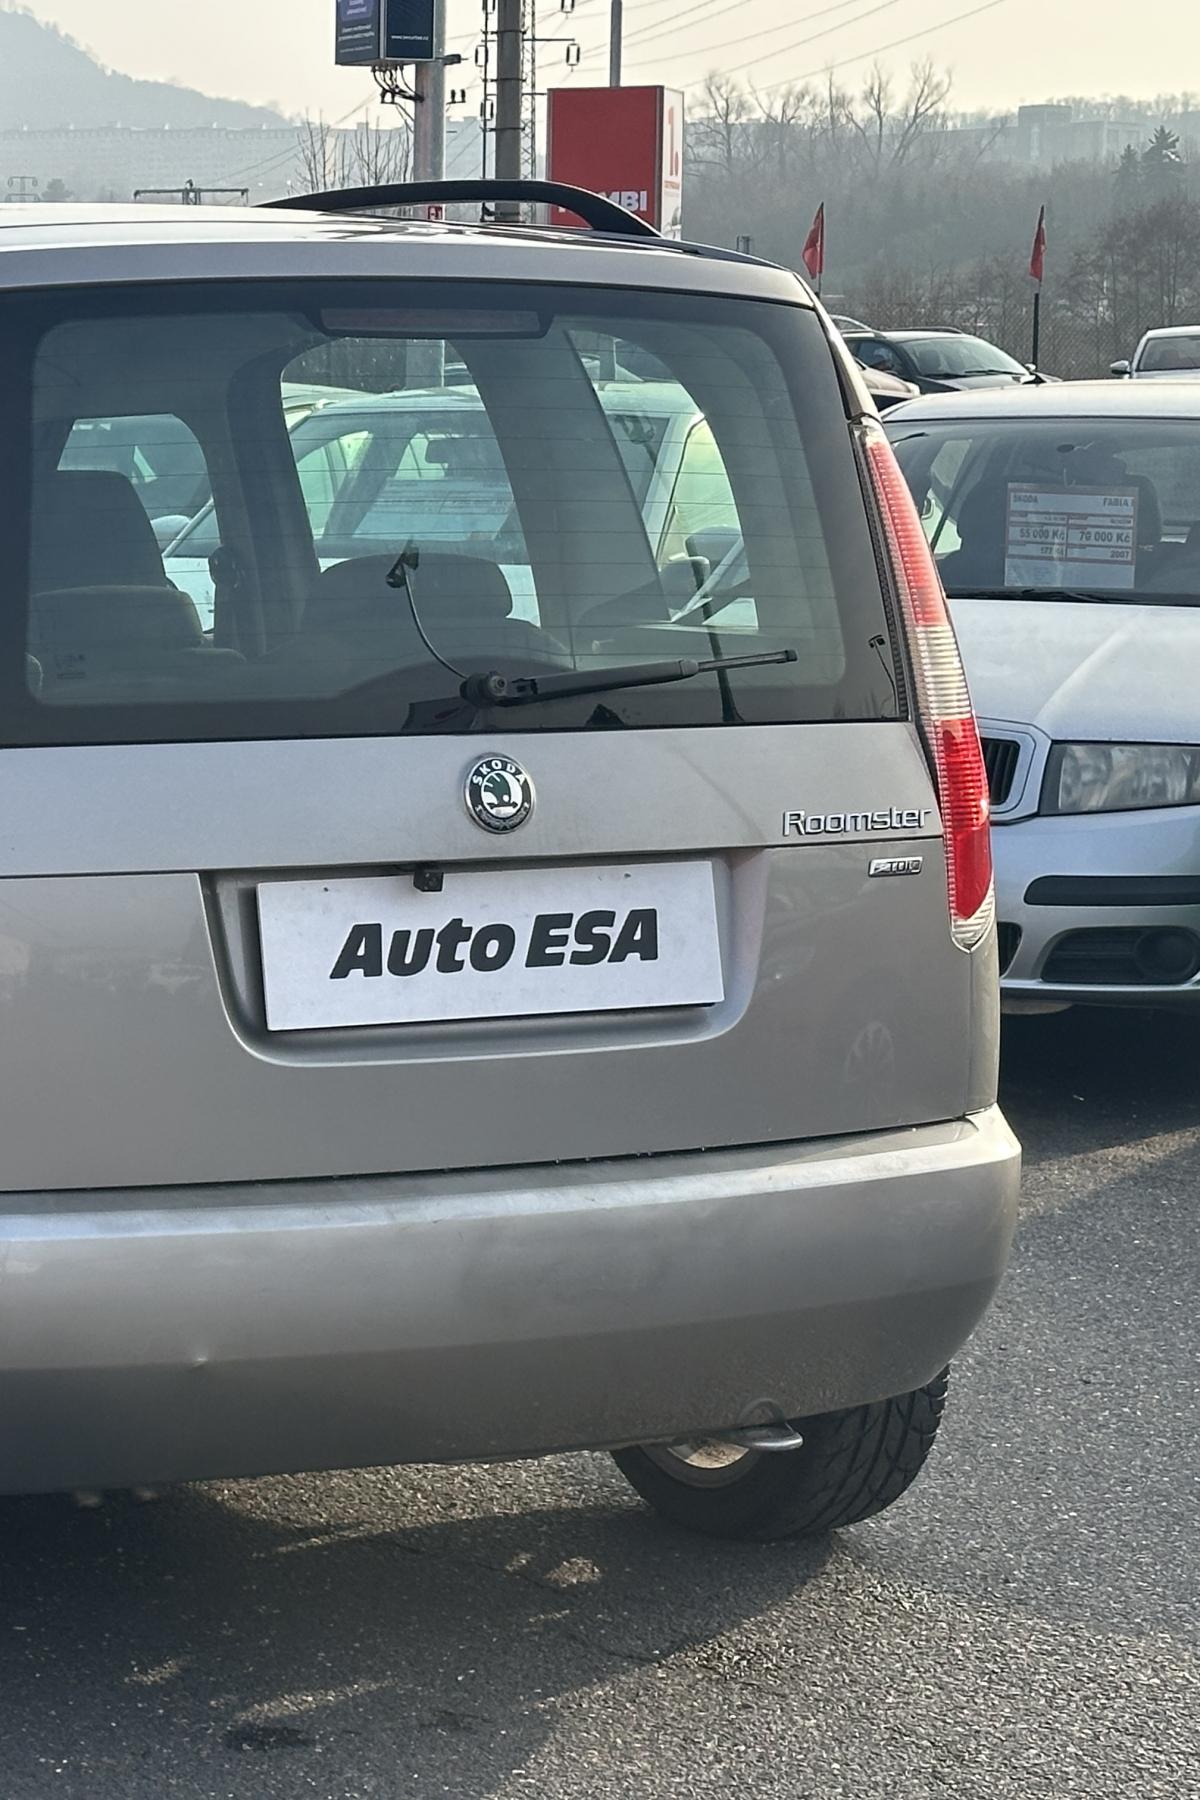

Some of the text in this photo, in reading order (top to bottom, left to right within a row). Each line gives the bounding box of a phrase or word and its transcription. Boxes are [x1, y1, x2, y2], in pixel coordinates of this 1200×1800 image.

[1079, 531, 1091, 541] 70
[1094, 532, 1113, 542] 000
[783, 806, 932, 837] Roomster
[329, 908, 658, 979] Auto ESA
